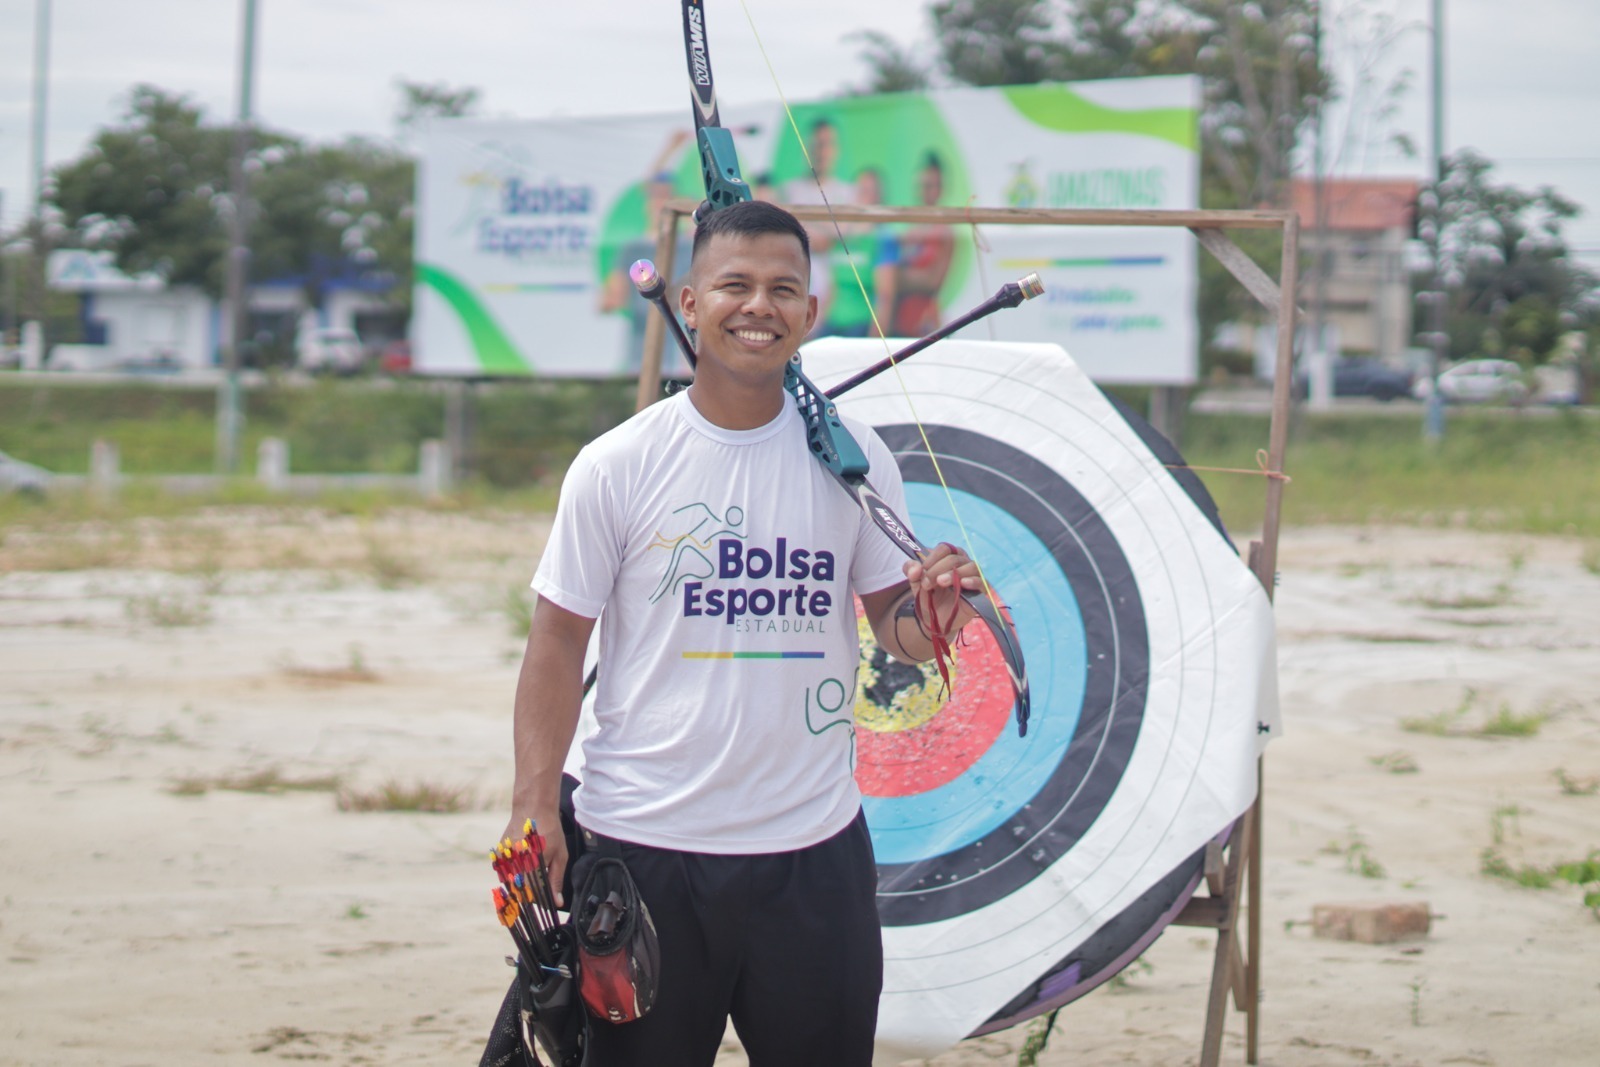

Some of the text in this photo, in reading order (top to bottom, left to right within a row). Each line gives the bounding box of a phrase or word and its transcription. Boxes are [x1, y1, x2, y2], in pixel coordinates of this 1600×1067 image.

[688, 5, 710, 86] WIAWIS
[718, 537, 835, 582] Bolsa
[683, 582, 832, 625] Esporte
[736, 619, 826, 633] ESTADUAL
